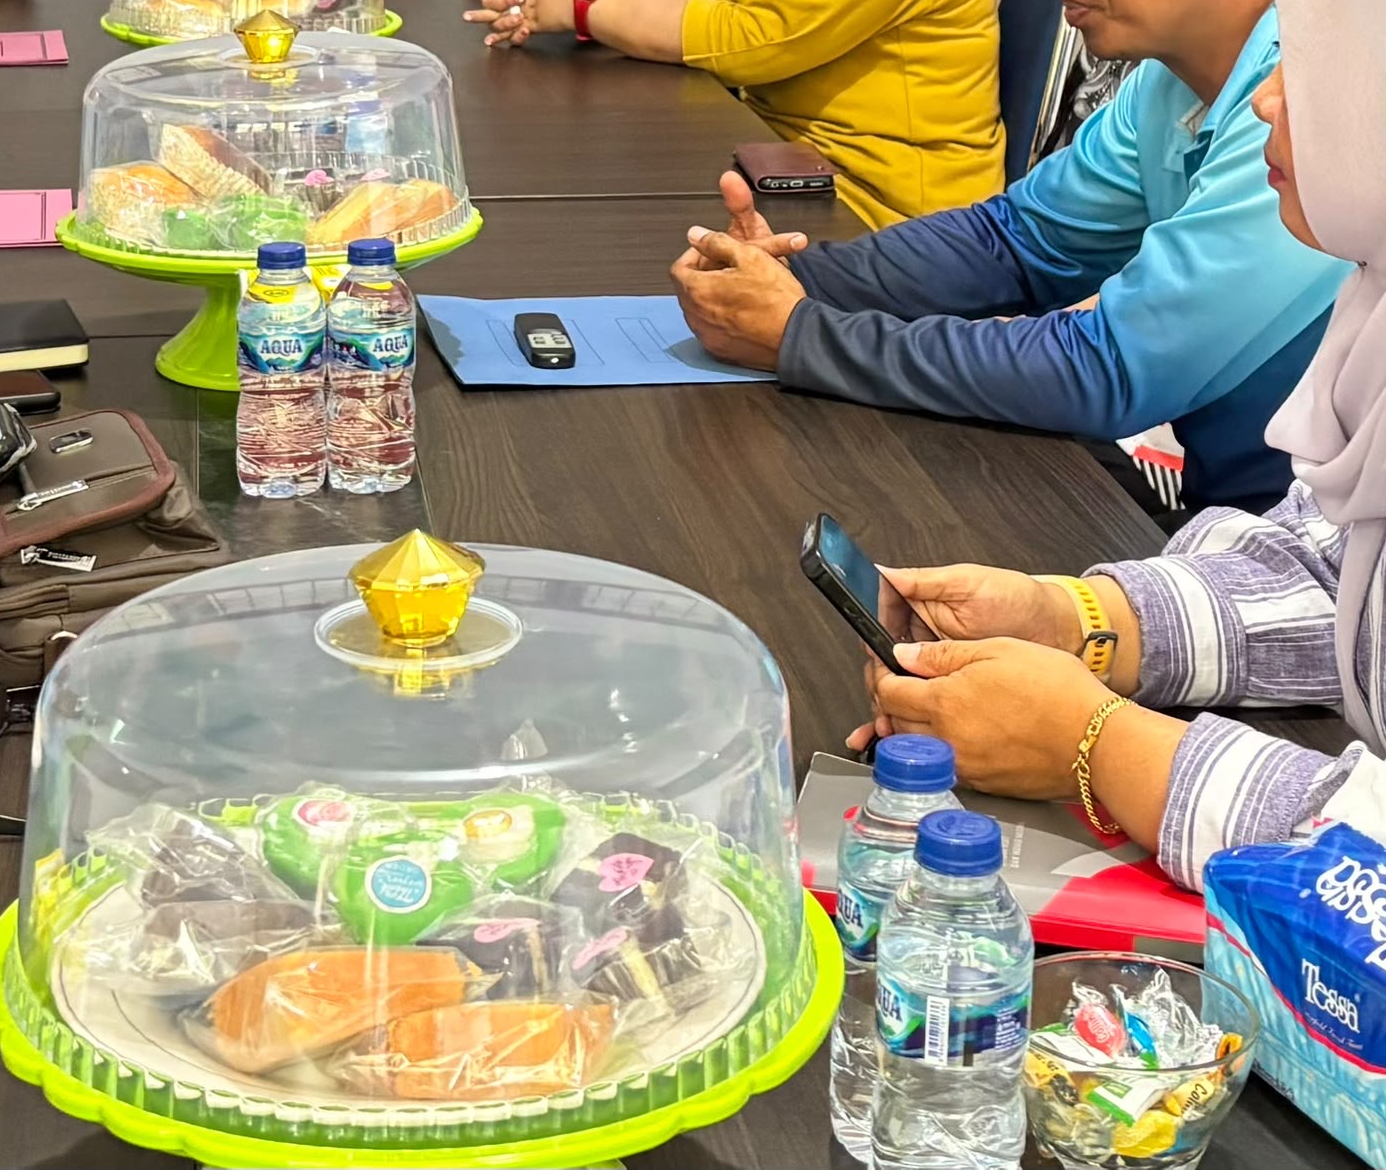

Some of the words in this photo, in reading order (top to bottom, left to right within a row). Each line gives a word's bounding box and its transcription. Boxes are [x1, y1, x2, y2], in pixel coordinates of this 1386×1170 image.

[260, 339, 302, 356] AQUA
[373, 335, 408, 353] AQUA
[1301, 958, 1361, 1034] Tessa
